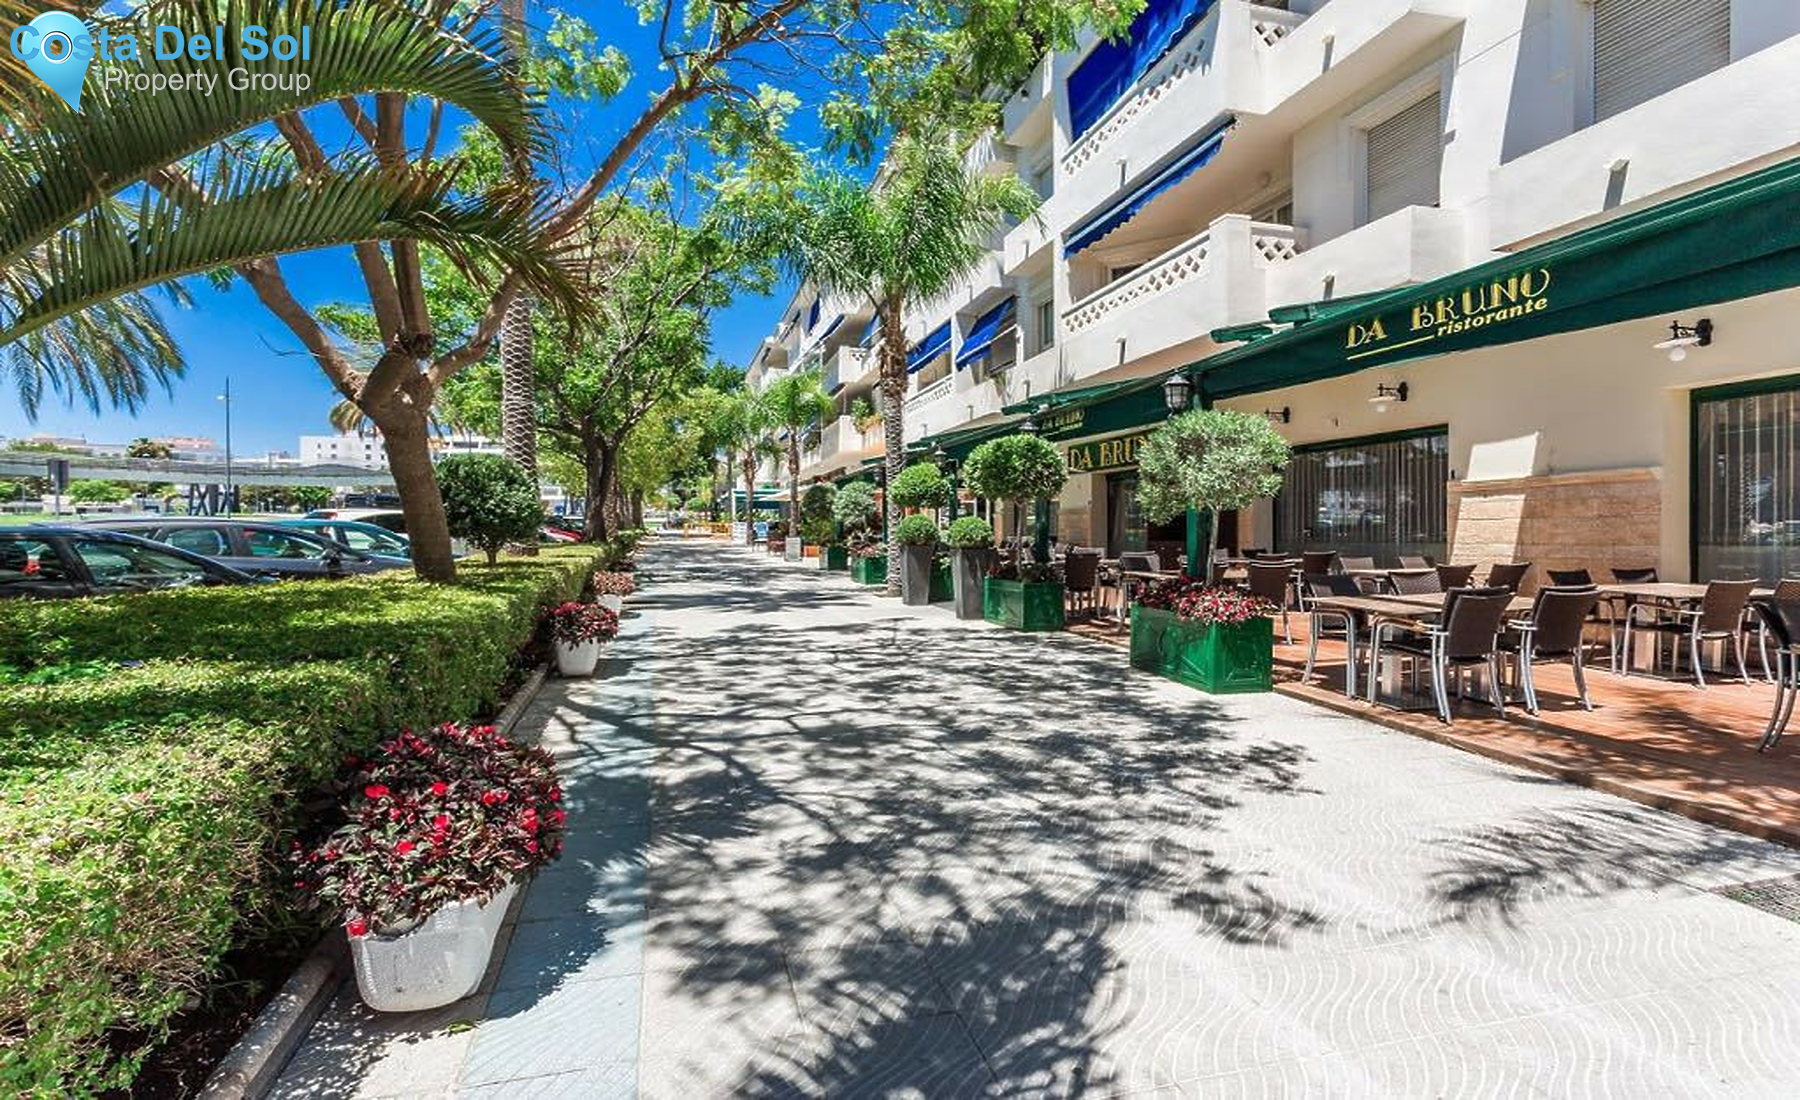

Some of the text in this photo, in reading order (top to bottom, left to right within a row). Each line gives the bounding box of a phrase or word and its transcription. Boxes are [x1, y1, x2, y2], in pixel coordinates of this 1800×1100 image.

[1345, 269, 1550, 348] DA BRUNO
[1437, 298, 1548, 336] ristorante
[1070, 446, 1093, 470] DA
